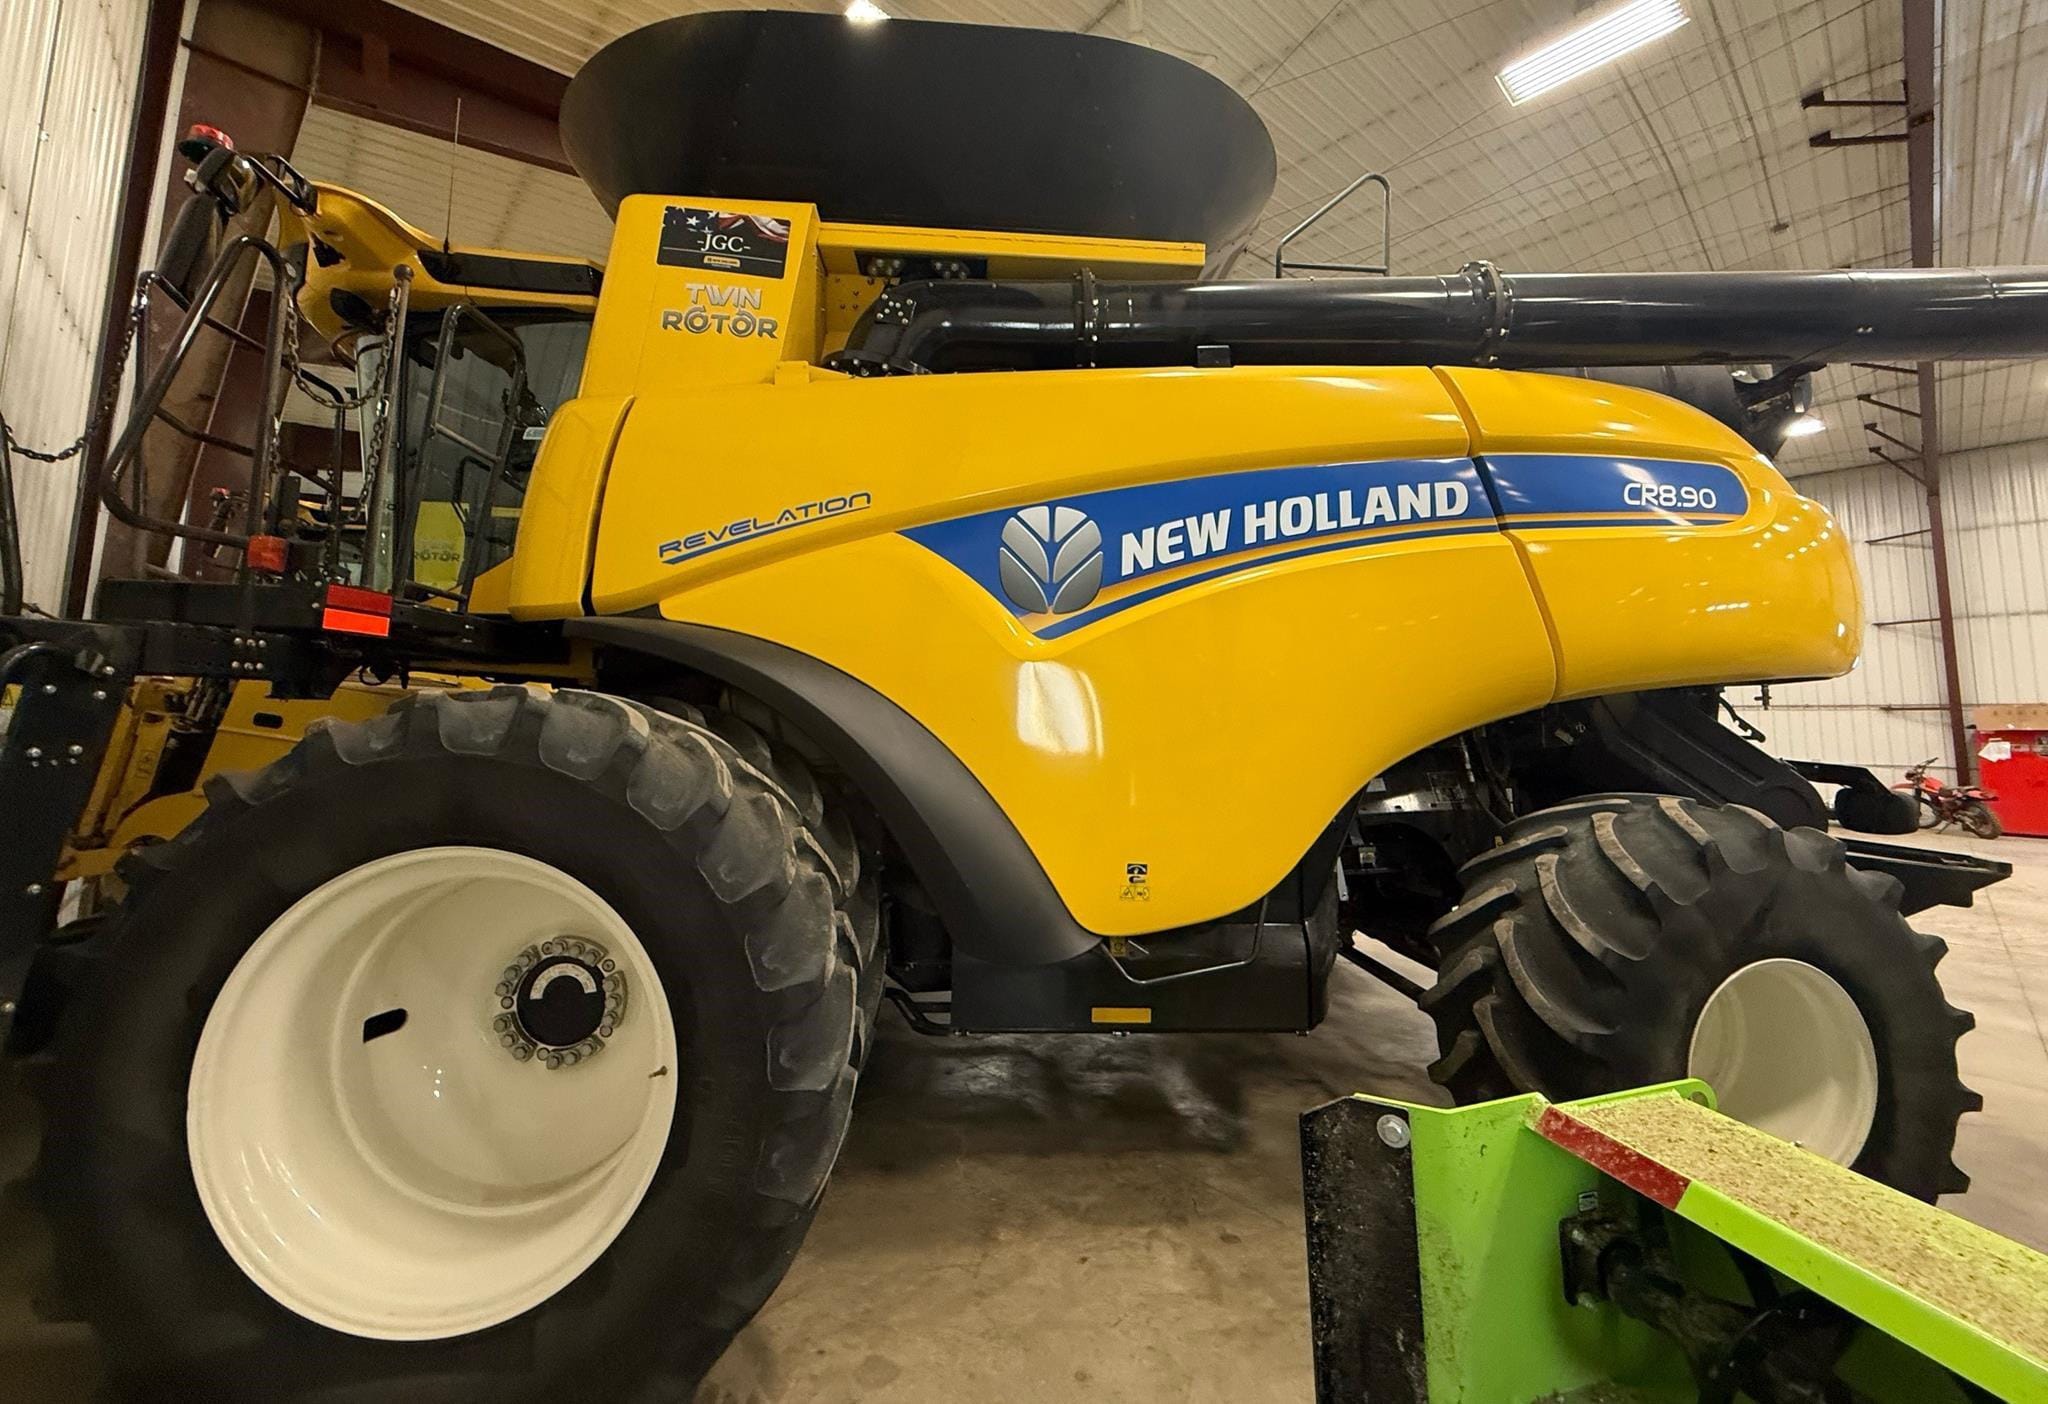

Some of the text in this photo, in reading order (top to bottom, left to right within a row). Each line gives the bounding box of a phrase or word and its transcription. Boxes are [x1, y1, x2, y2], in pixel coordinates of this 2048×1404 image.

[684, 283, 762, 310] TWIN
[662, 305, 778, 339] ROTOR
[1623, 483, 1717, 509] CR8.90
[659, 492, 871, 558] REVELATION
[1121, 481, 1469, 576] NEW HOLLAND
